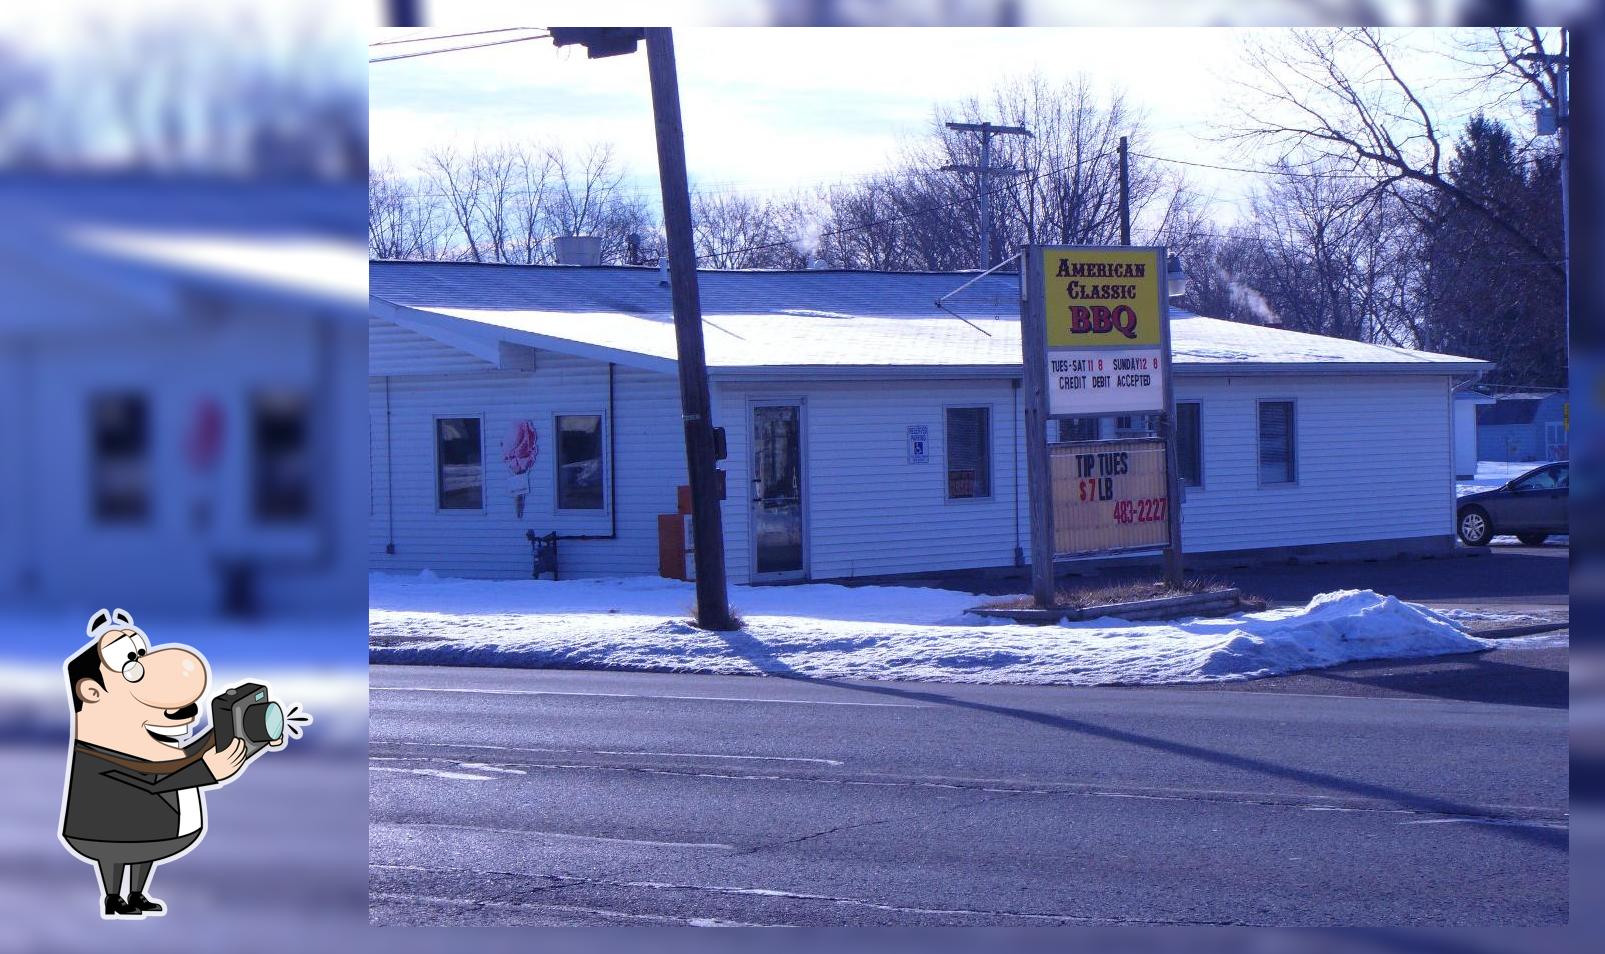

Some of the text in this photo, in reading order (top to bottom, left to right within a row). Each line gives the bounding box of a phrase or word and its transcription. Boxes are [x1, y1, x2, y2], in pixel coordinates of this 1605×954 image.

[1056, 258, 1146, 277] AMERICAN
[1067, 281, 1136, 299] CLASSIC
[1068, 305, 1138, 339] BBQ
[1098, 359, 1103, 371] 8
[1153, 359, 1158, 369] 8
[1059, 375, 1151, 389] CREDIT DEBIT ACCEPTED
[1076, 452, 1128, 477] TIP TUES
[1098, 478, 1113, 501] LB
[1113, 498, 1167, 524] 483-2227
